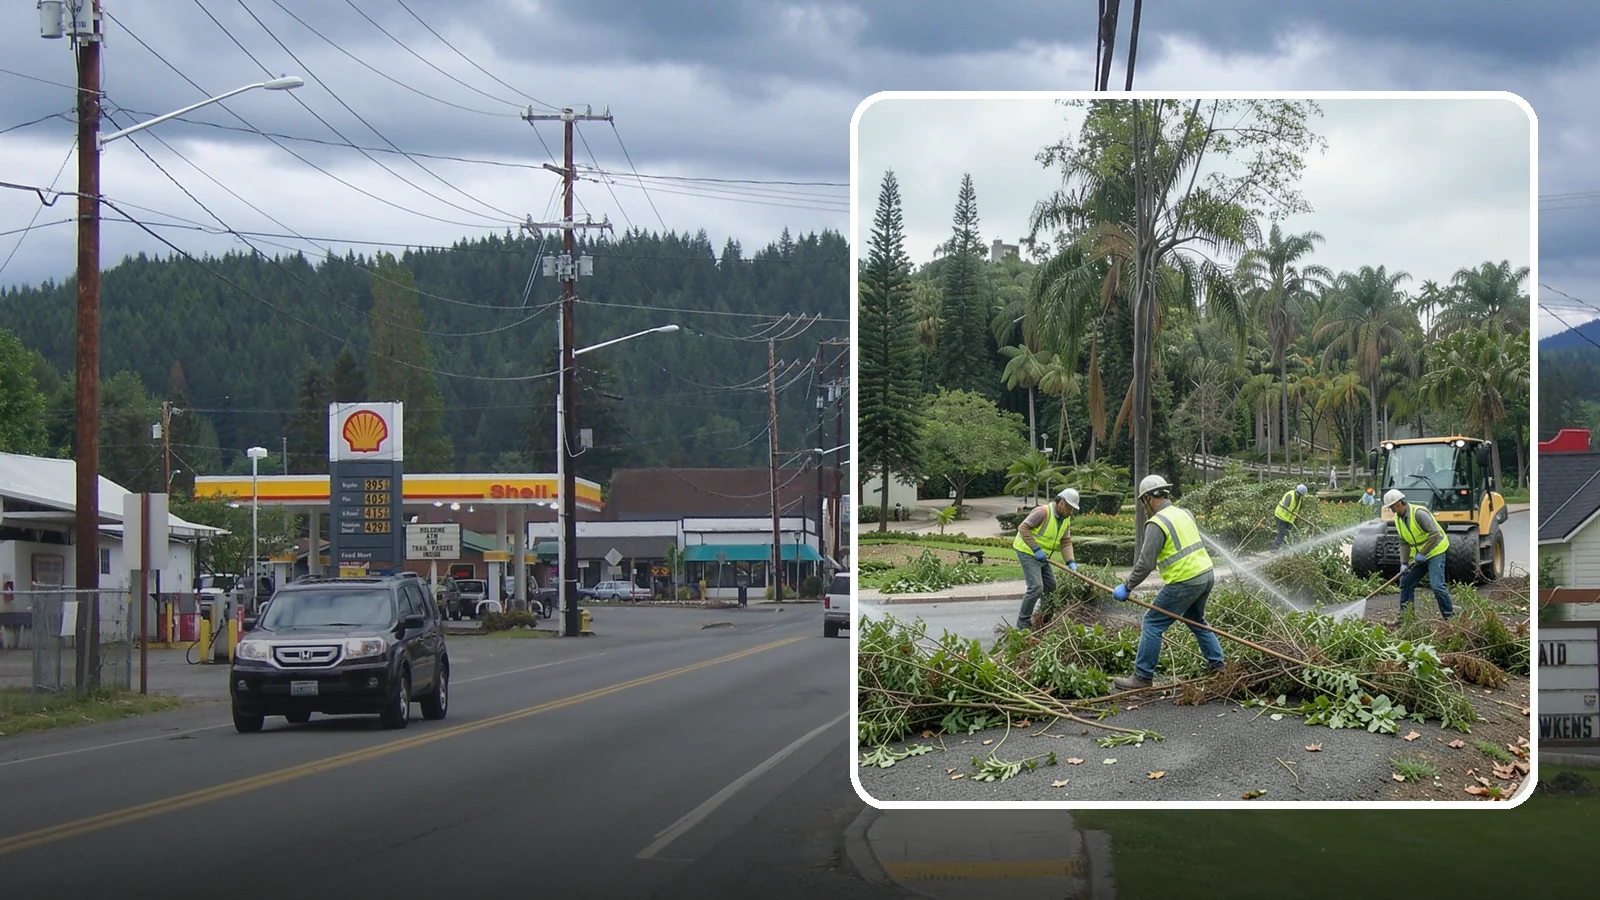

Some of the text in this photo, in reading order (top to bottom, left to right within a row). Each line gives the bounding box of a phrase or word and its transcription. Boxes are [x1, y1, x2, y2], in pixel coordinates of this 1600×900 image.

[366, 480, 383, 490] 395
[490, 484, 547, 499] Shell
[366, 494, 383, 504] 405
[365, 508, 383, 518] 415
[366, 522, 383, 532] 429
[1539, 643, 1566, 665] AID
[1539, 716, 1592, 738] WKENS
